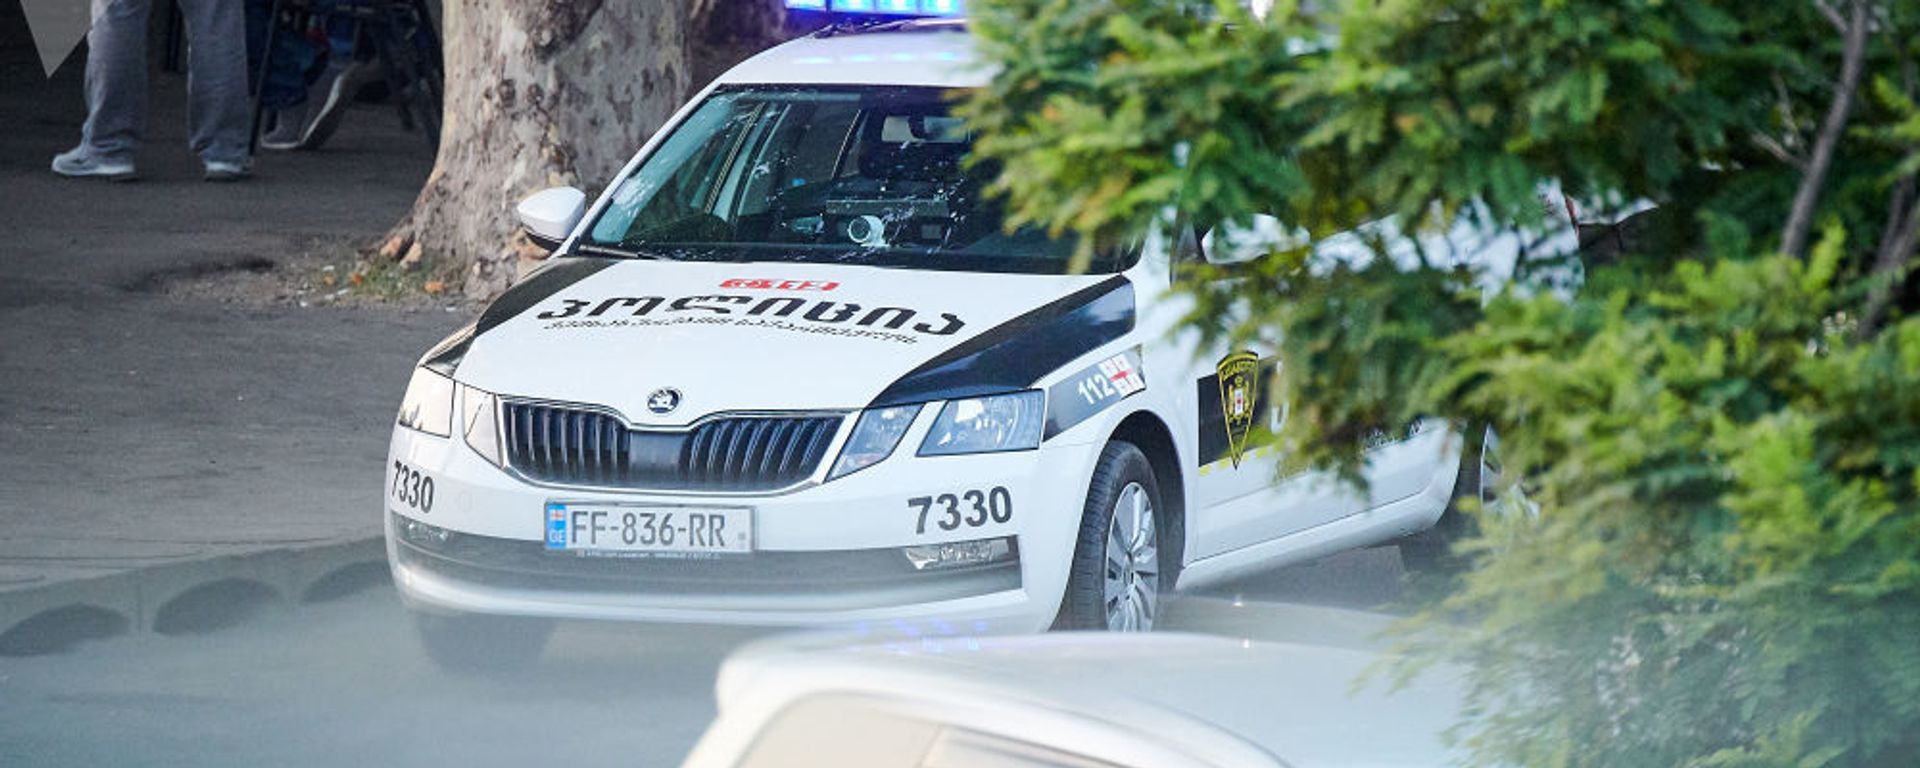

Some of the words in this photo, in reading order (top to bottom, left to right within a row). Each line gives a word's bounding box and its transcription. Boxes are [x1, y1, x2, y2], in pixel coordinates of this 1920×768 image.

[537, 294, 966, 335] პოლიცია
[1078, 374, 1116, 405] 112
[391, 458, 434, 514] 7330
[571, 510, 726, 547] FF-836-RR
[907, 485, 1013, 535] 7330
